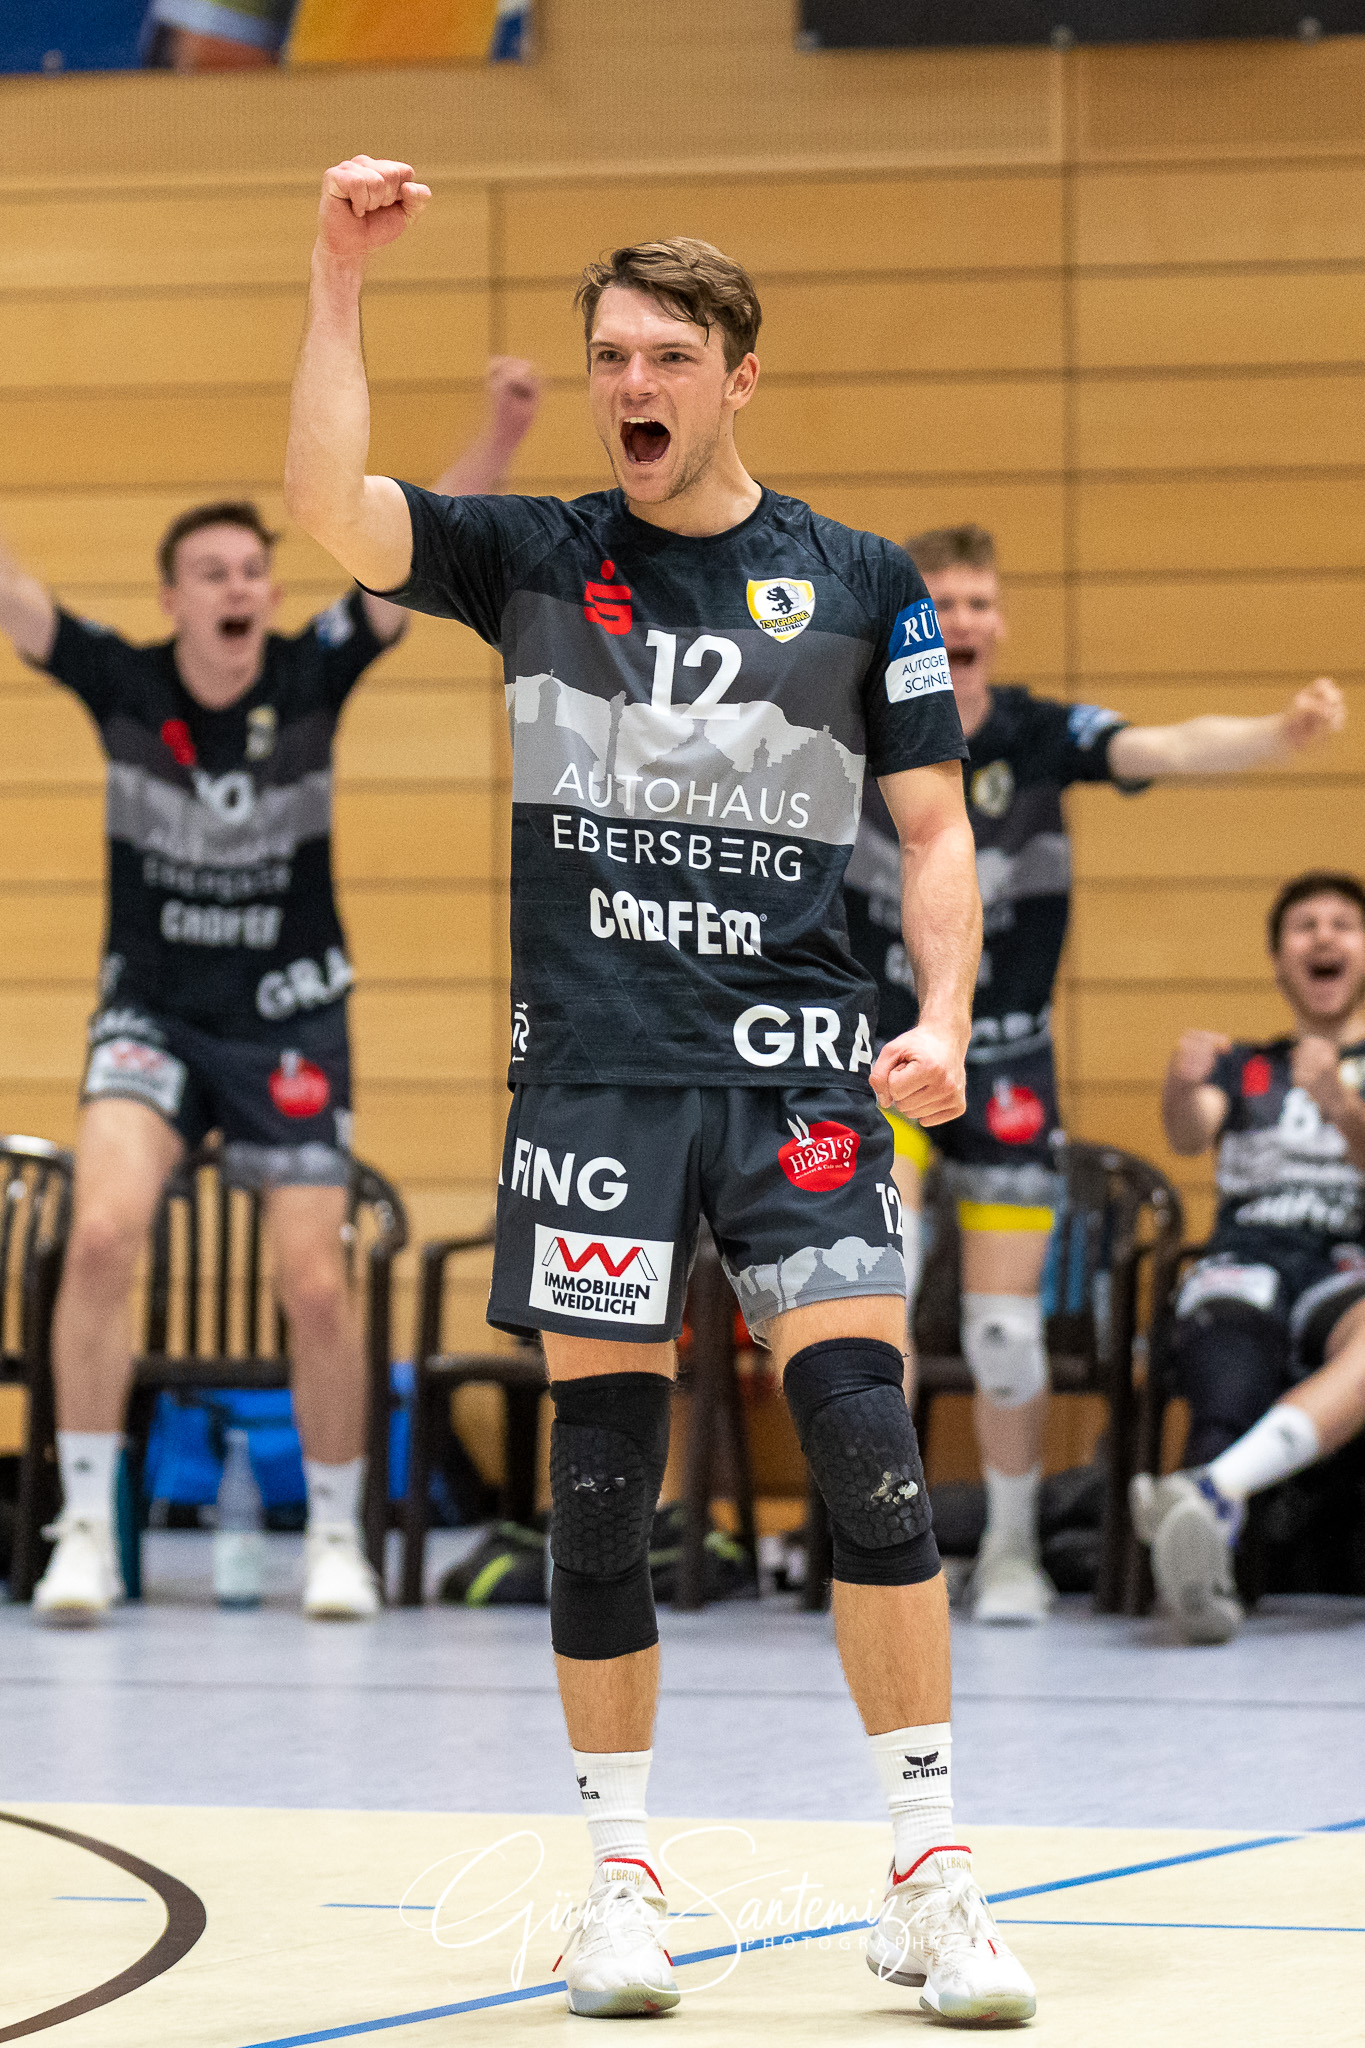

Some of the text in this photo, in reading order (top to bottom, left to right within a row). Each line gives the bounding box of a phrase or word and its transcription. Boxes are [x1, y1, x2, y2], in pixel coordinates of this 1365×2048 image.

[760, 610, 811, 630] TSV GRAFING
[773, 622, 804, 634] VOLLEYBALL
[645, 629, 743, 721] 12
[902, 654, 948, 676] AUTOGE
[905, 671, 952, 694] SCHNE
[552, 762, 811, 829] AUTOHAUS
[552, 814, 804, 882] EBERSBERG
[498, 1137, 629, 1212] FING
[875, 1183, 903, 1236] 12
[544, 1271, 651, 1300] IMMOBILIEN
[552, 1289, 636, 1316] WEIDLICH
[902, 1765, 948, 1780] erima
[580, 1789, 601, 1800] ma
